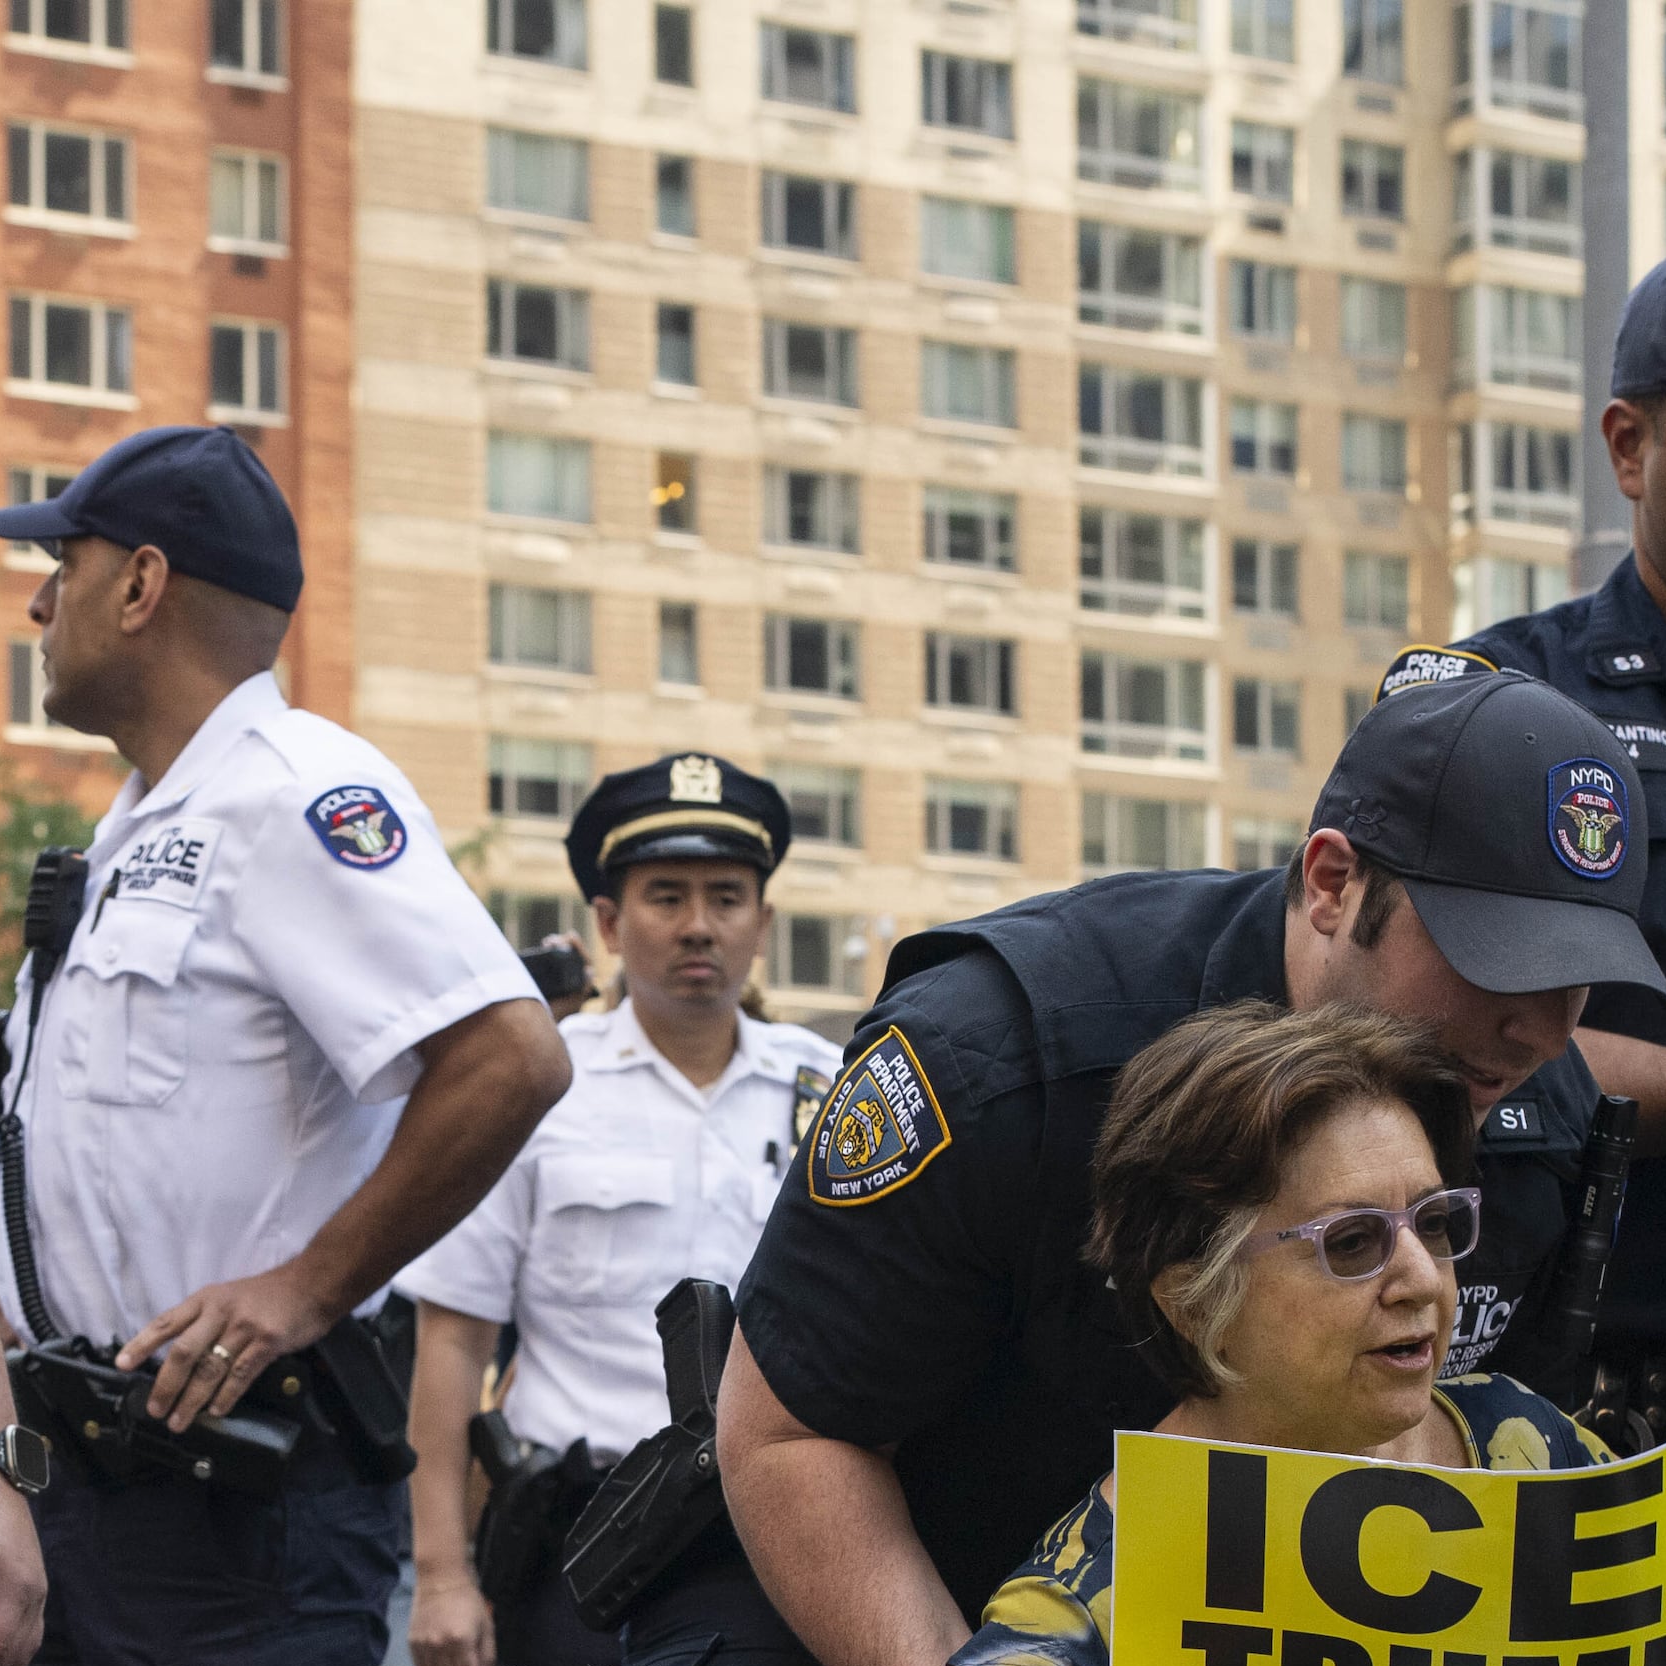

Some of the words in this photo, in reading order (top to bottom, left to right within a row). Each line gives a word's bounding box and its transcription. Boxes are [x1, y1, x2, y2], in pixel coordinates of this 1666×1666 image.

[1406, 653, 1468, 672] POLICE
[1383, 667, 1464, 691] DEPARTM
[1570, 767, 1614, 794] NYPD
[316, 788, 379, 822] POLICE
[1576, 793, 1610, 809] POLICE
[887, 1053, 925, 1117] POLICE
[827, 1081, 853, 1126] CITY
[866, 1052, 921, 1154] DEPARTMENT
[1499, 1107, 1528, 1130] S1
[818, 1131, 831, 1160] OF
[831, 1180, 861, 1196] NEW
[863, 1160, 908, 1192] YORK
[1583, 1185, 1597, 1217] NYPD
[1450, 1293, 1523, 1345] LIC
[1437, 1359, 1478, 1379] ROUP
[1204, 1449, 1664, 1642] ICE
